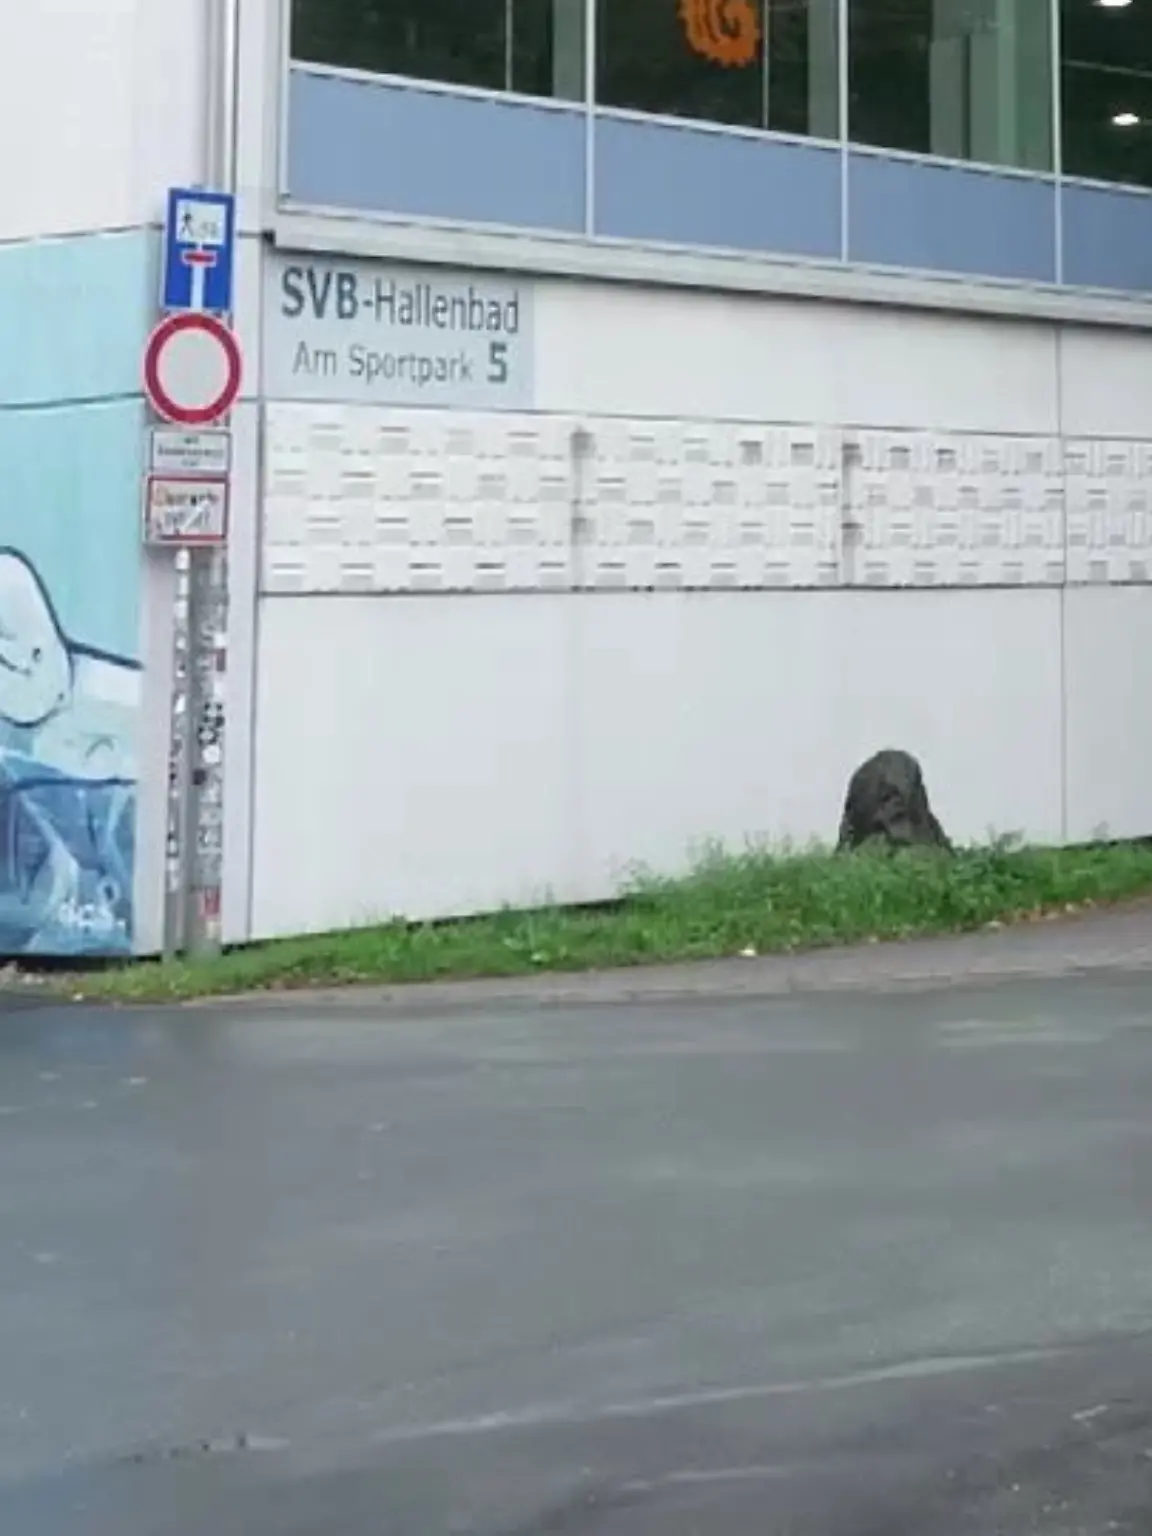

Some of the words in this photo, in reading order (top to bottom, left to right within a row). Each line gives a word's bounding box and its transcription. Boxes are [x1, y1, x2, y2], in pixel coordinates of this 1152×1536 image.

[281, 266, 519, 333] SVB-Hallenbad
[293, 341, 337, 376] Am
[349, 343, 473, 384] Sportpark
[487, 342, 508, 383] 5
